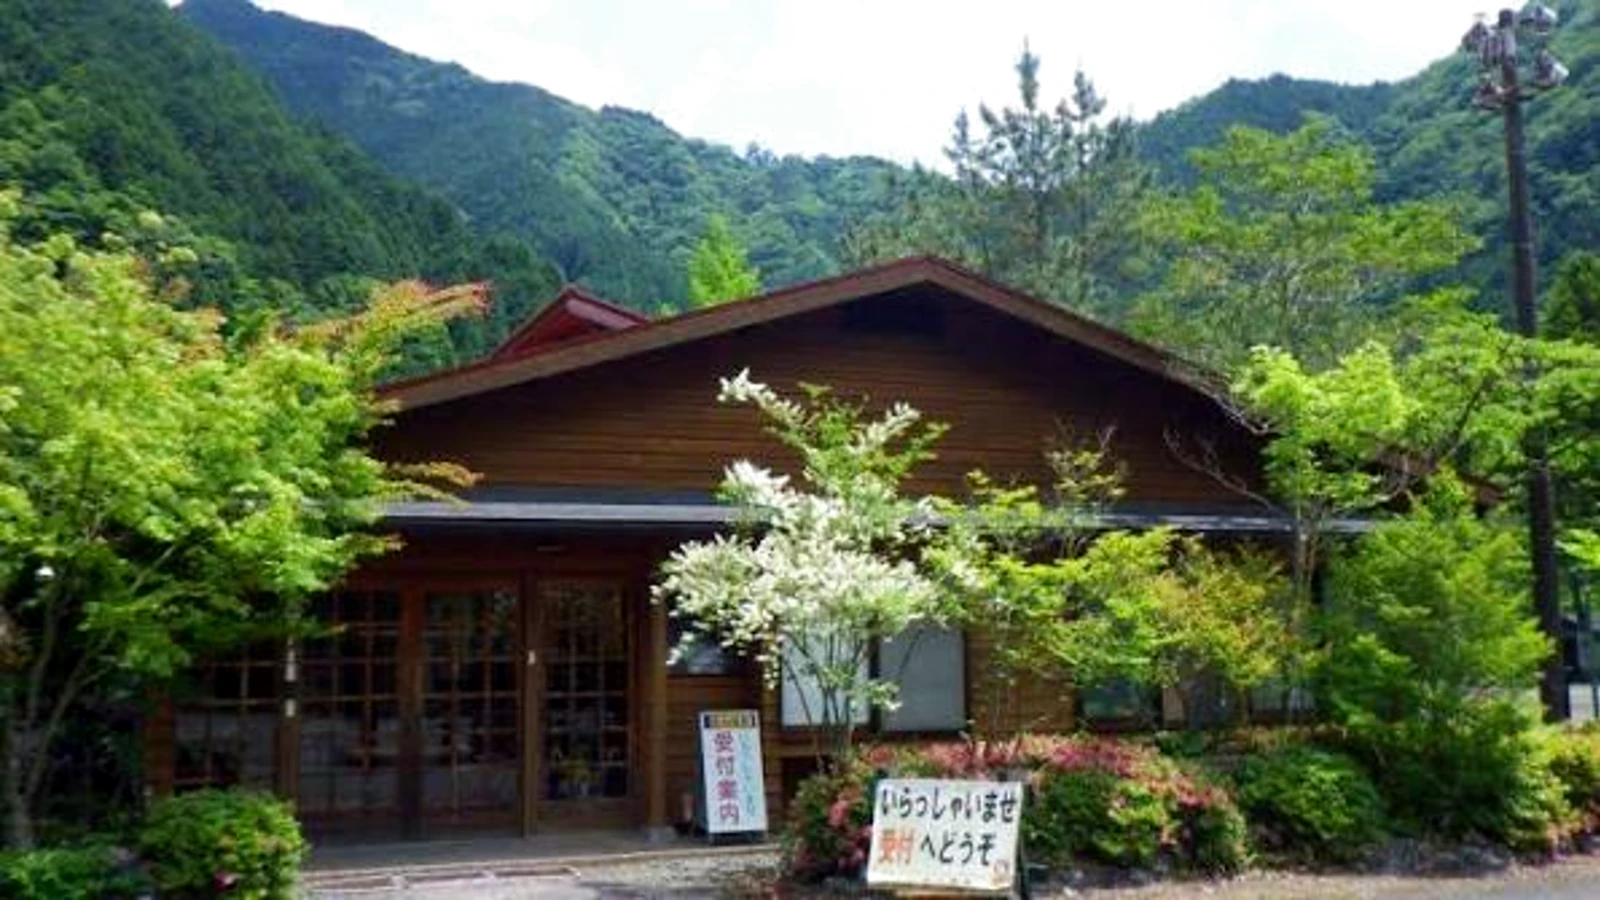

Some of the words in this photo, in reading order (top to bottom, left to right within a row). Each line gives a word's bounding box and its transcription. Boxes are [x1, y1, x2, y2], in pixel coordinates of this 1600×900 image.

[714, 731, 740, 825] 受付案内
[881, 786, 1017, 823] いらっしゃいませ
